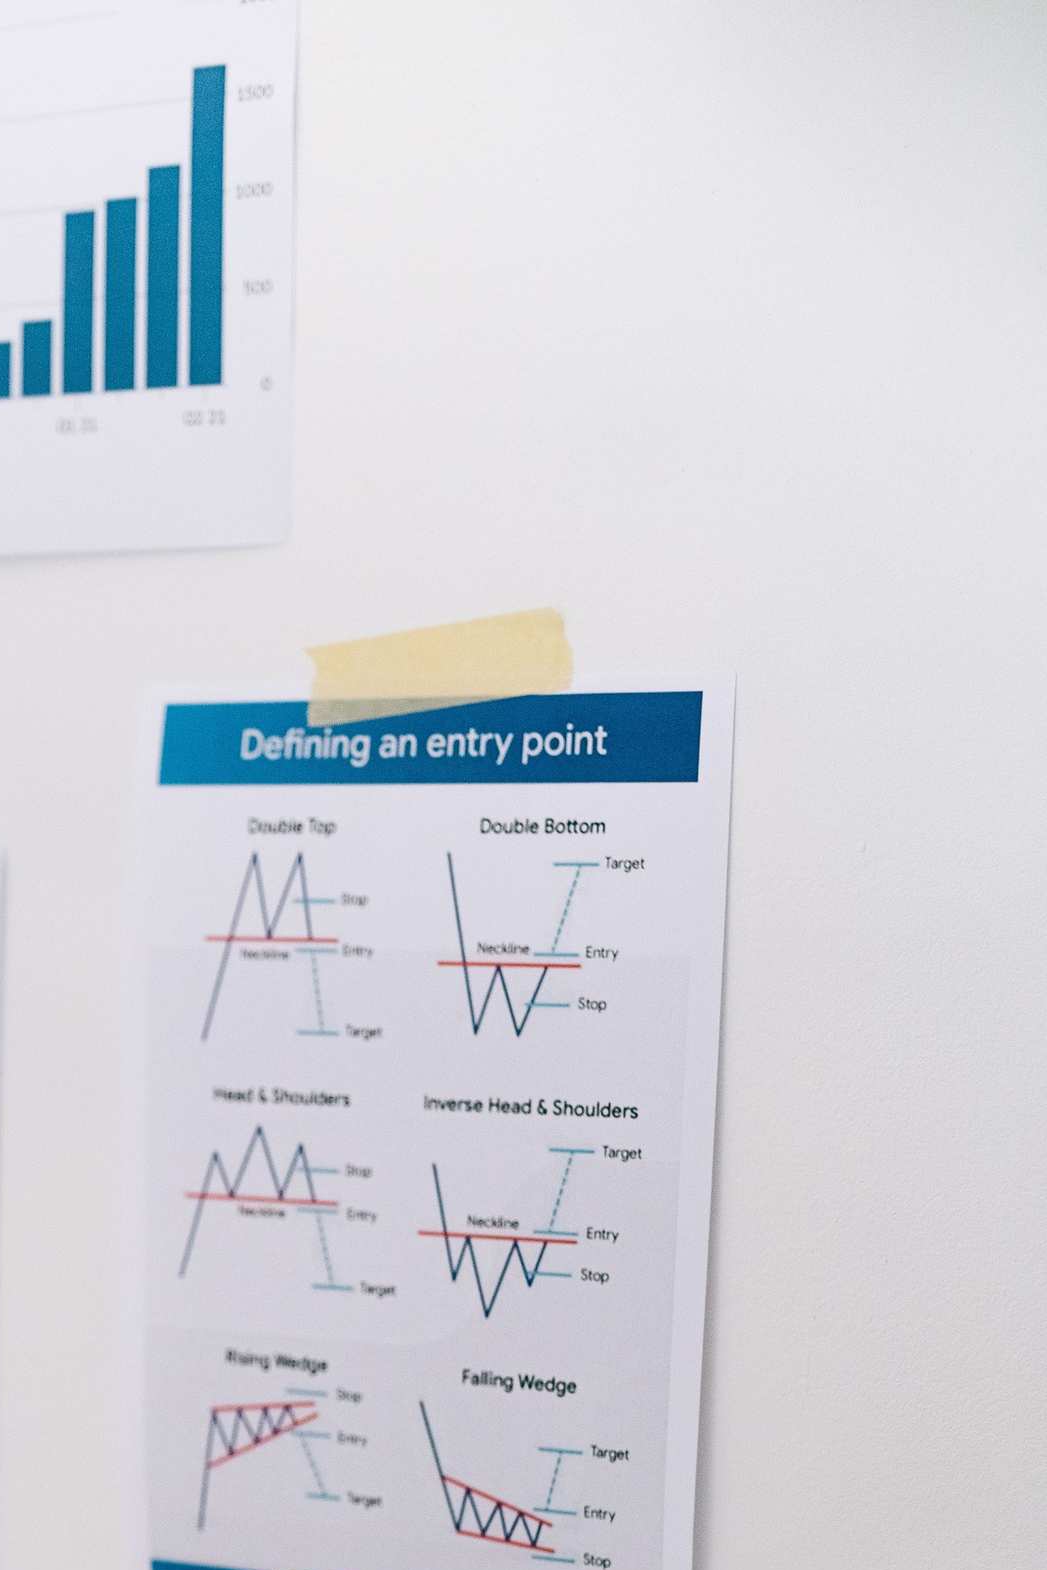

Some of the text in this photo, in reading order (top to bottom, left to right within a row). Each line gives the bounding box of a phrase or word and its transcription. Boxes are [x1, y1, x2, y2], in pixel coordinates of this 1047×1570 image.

[239, 725, 608, 768] Defining an entry point
[248, 818, 337, 837] Double Top
[480, 819, 606, 834] Double Bottom
[605, 857, 645, 873] Target
[342, 945, 373, 959] Entry
[477, 942, 529, 956] Neckline
[585, 946, 618, 962] Entry
[578, 998, 607, 1013] Stop
[345, 1026, 383, 1040] Target
[213, 1087, 351, 1109] Head & Shoulders
[424, 1096, 639, 1120] Inverse Head & Shoulders
[602, 1146, 642, 1161] Target
[467, 1215, 520, 1231] Neckline
[586, 1227, 619, 1244] Entry
[580, 1269, 610, 1285] Stop
[360, 1283, 396, 1297] Target
[226, 1349, 328, 1376] Rising Wedge
[461, 1370, 577, 1396] Falling Wedge
[590, 1446, 630, 1463] Target
[583, 1507, 616, 1524] Entry
[583, 1554, 612, 1570] Stop
